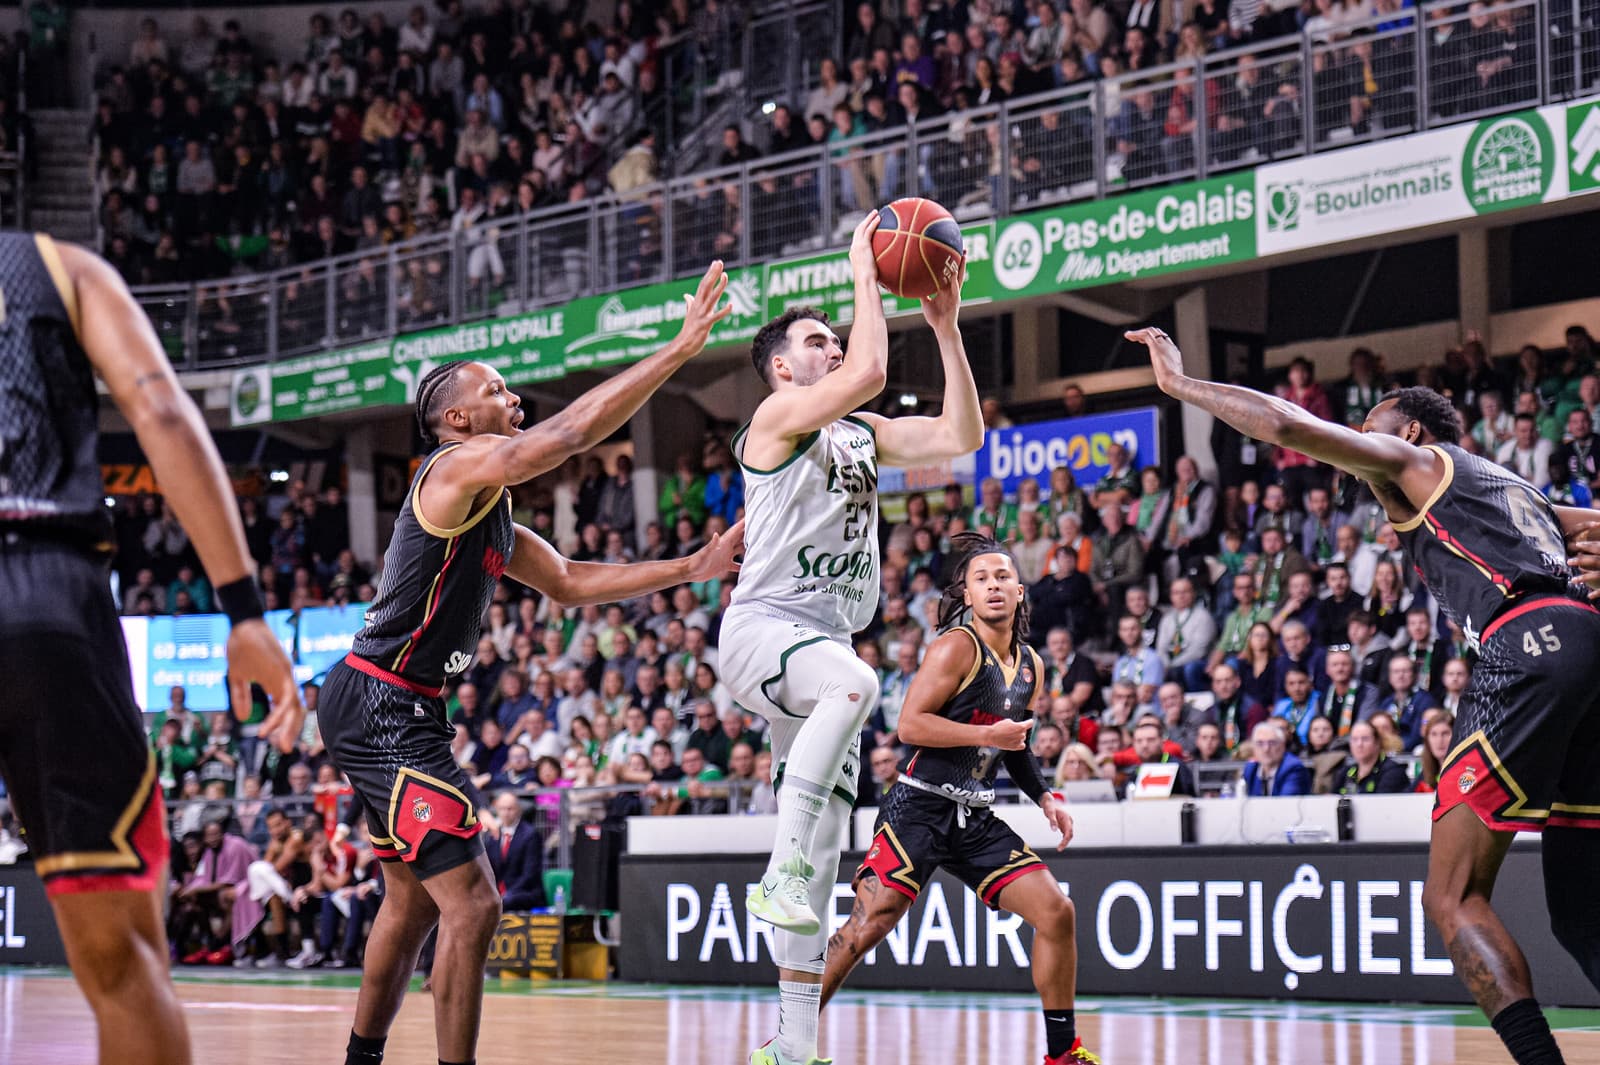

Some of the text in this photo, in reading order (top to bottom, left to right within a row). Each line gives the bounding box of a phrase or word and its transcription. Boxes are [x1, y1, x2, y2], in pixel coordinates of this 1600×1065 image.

[1316, 169, 1453, 215] Boulonnais
[1003, 240, 1033, 270] 62
[1106, 234, 1230, 277] Département
[393, 327, 489, 364] CHEMINÉES
[490, 312, 564, 348] D'OPALE
[990, 428, 1139, 480] biocoop
[1522, 624, 1562, 657] 45
[971, 747, 992, 780] 3
